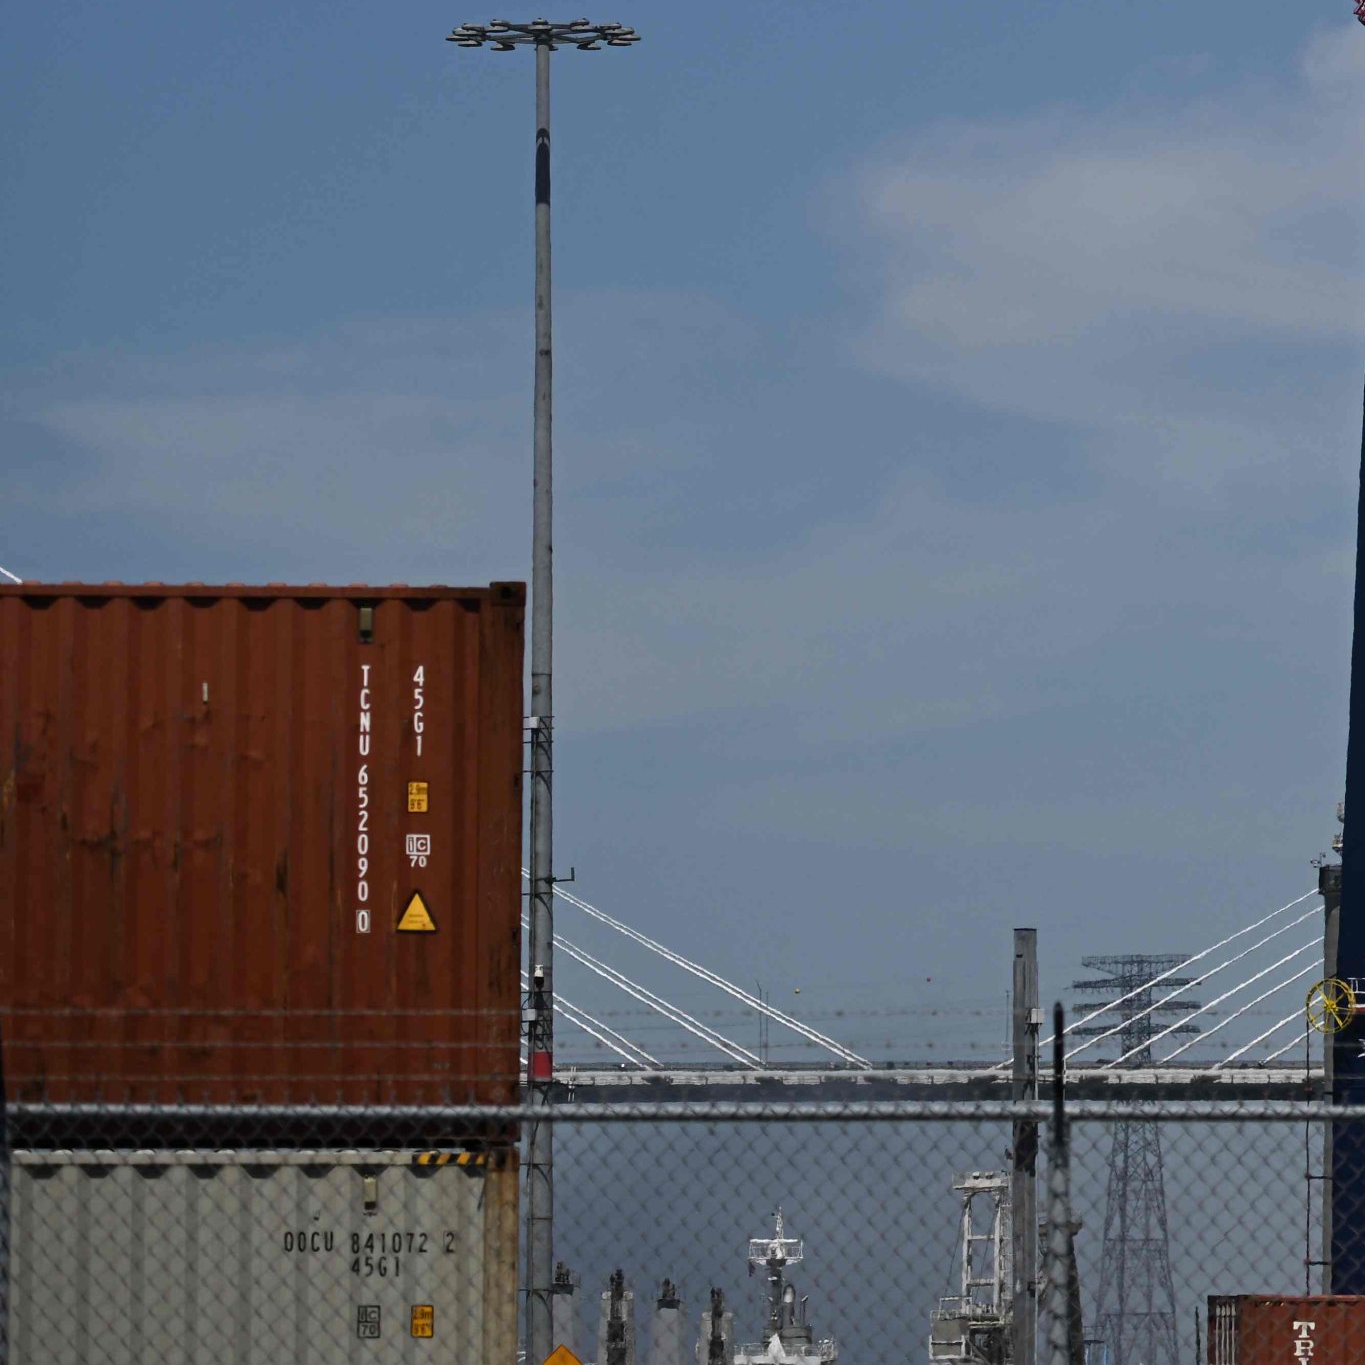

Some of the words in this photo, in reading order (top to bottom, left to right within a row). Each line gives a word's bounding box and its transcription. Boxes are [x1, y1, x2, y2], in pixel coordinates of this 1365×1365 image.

[358, 665, 371, 756] TCNU
[412, 665, 425, 757] 45G1
[357, 764, 369, 902] 652090
[409, 855, 427, 868] 70
[351, 1232, 428, 1254] 841072
[444, 1232, 456, 1254] 2
[351, 1256, 400, 1277] 45G1
[361, 1324, 377, 1335] 70
